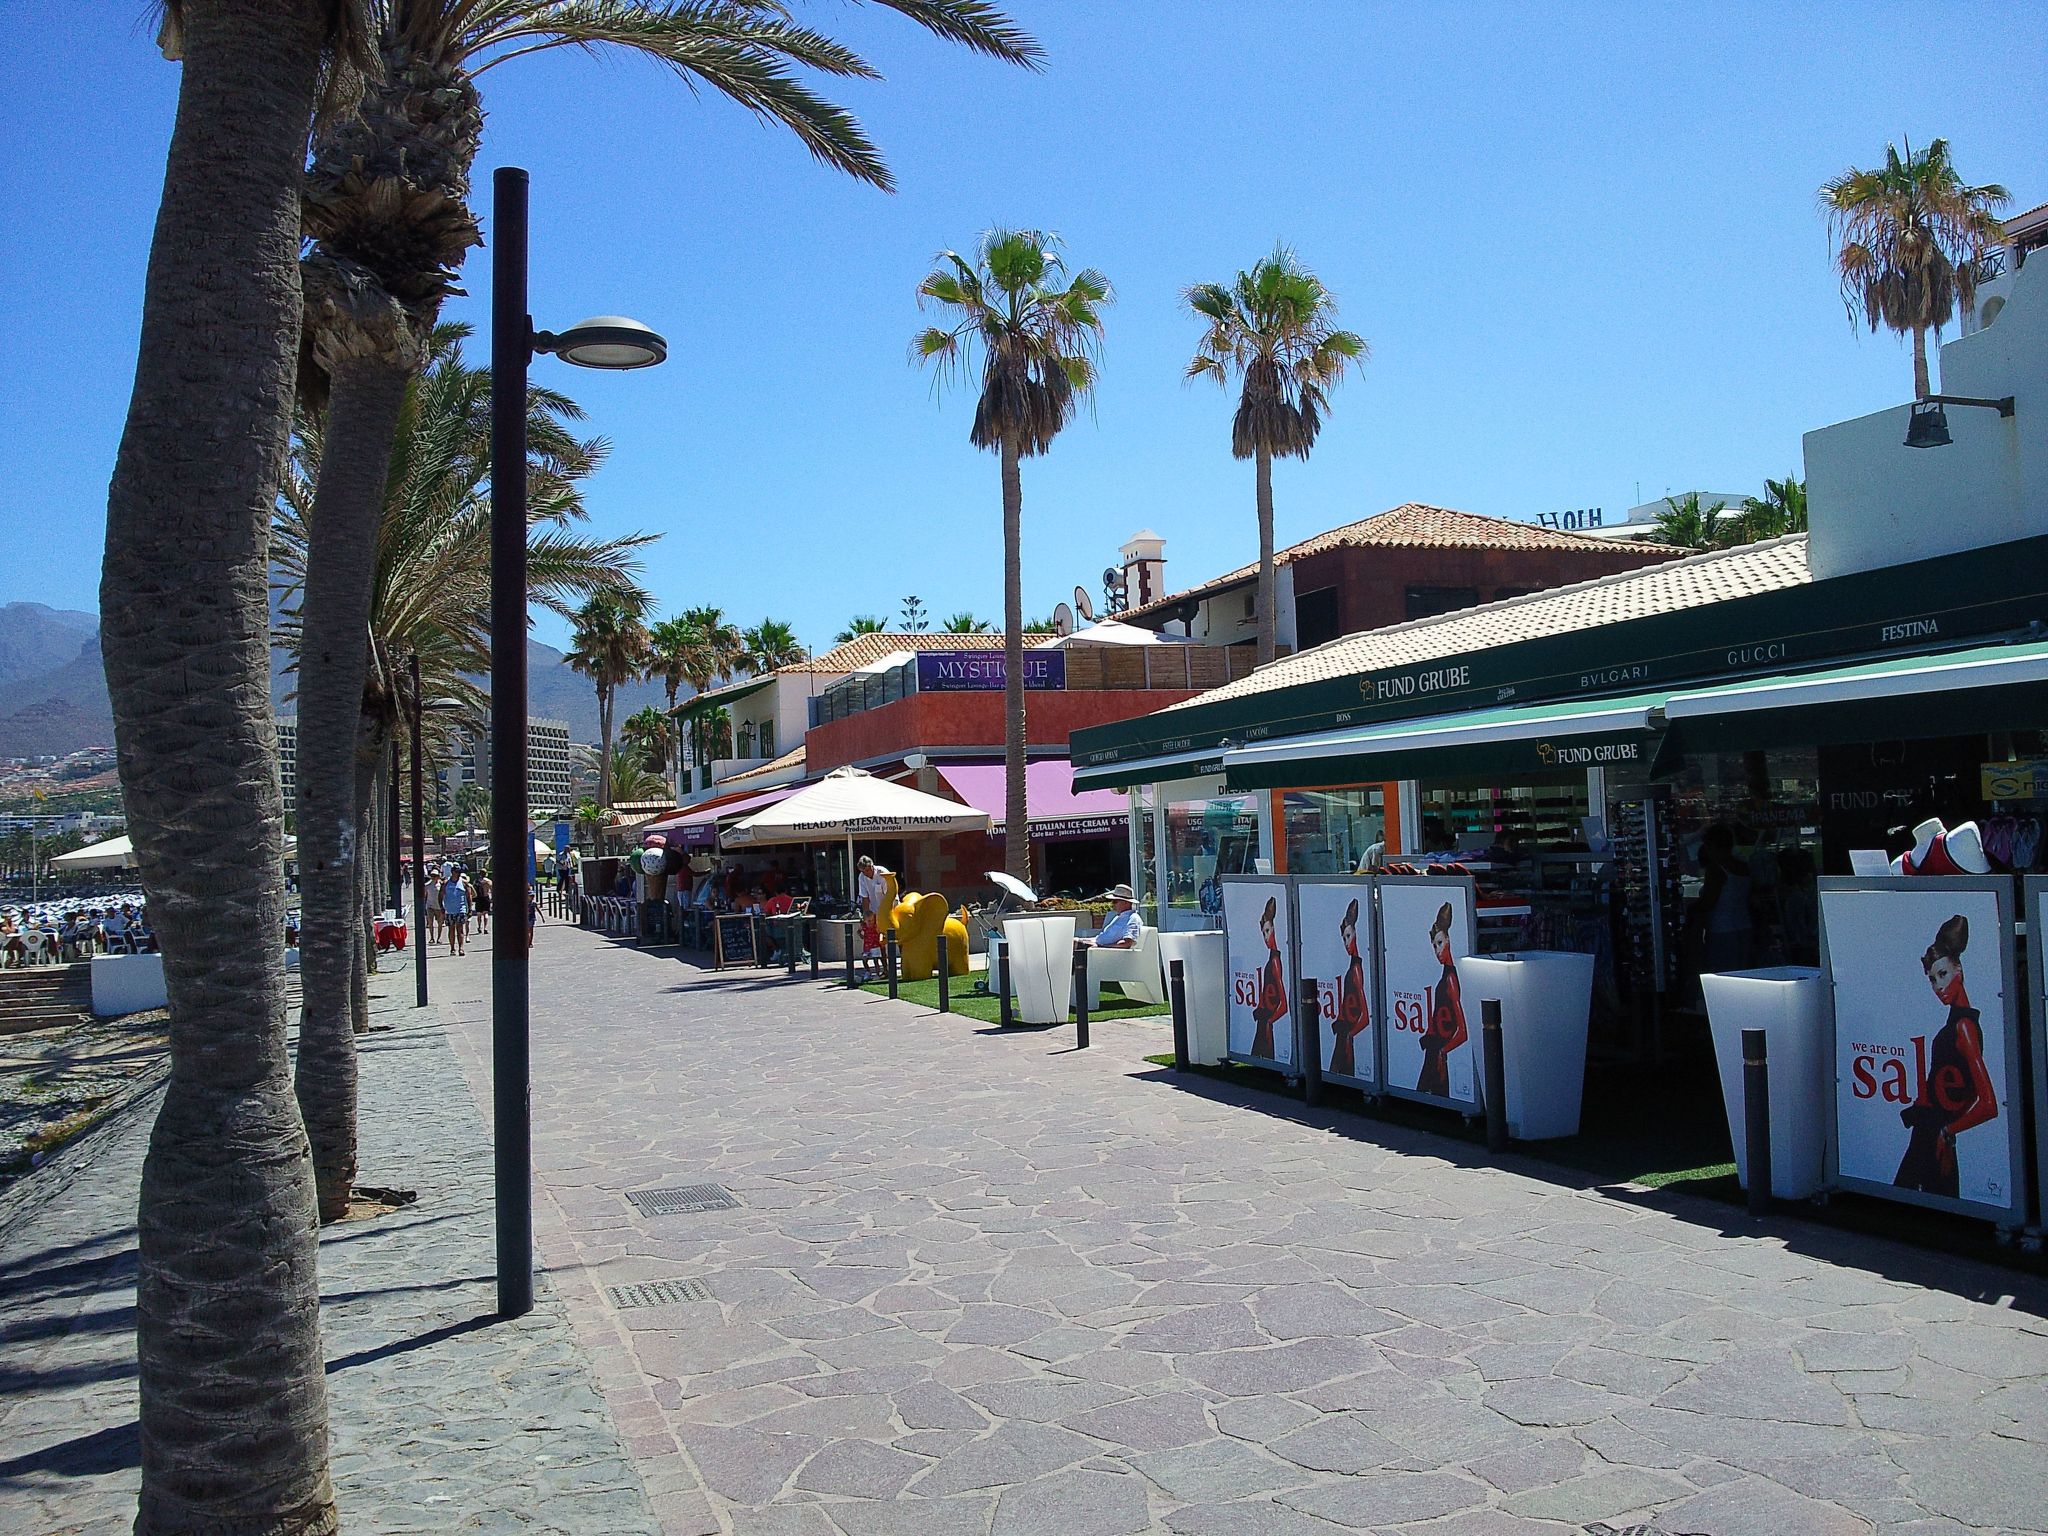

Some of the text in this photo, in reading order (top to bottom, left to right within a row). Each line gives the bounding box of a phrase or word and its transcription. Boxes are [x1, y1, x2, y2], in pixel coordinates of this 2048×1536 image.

[1881, 619, 1939, 641] FESTINA
[1727, 643, 1785, 664] GUCCI
[1377, 666, 1471, 699] FUND GRUBE
[1581, 665, 1648, 687] BVLGARI
[1557, 743, 1638, 764] FUND GRUBE
[1830, 791, 1878, 810] FUND
[792, 815, 952, 831] HELADO ARTESANAL ITALIANO
[1035, 823, 1066, 832] ITALIAN
[1068, 819, 1109, 829] ICE-CREAM
[1059, 828, 1076, 836] Juices
[1235, 966, 1277, 1012] sale
[1316, 974, 1360, 1022] ale
[1393, 991, 1422, 1001] we are on
[1394, 985, 1452, 1039] sale
[1852, 1042, 1905, 1057] we are on
[1852, 1035, 1968, 1112] sale
